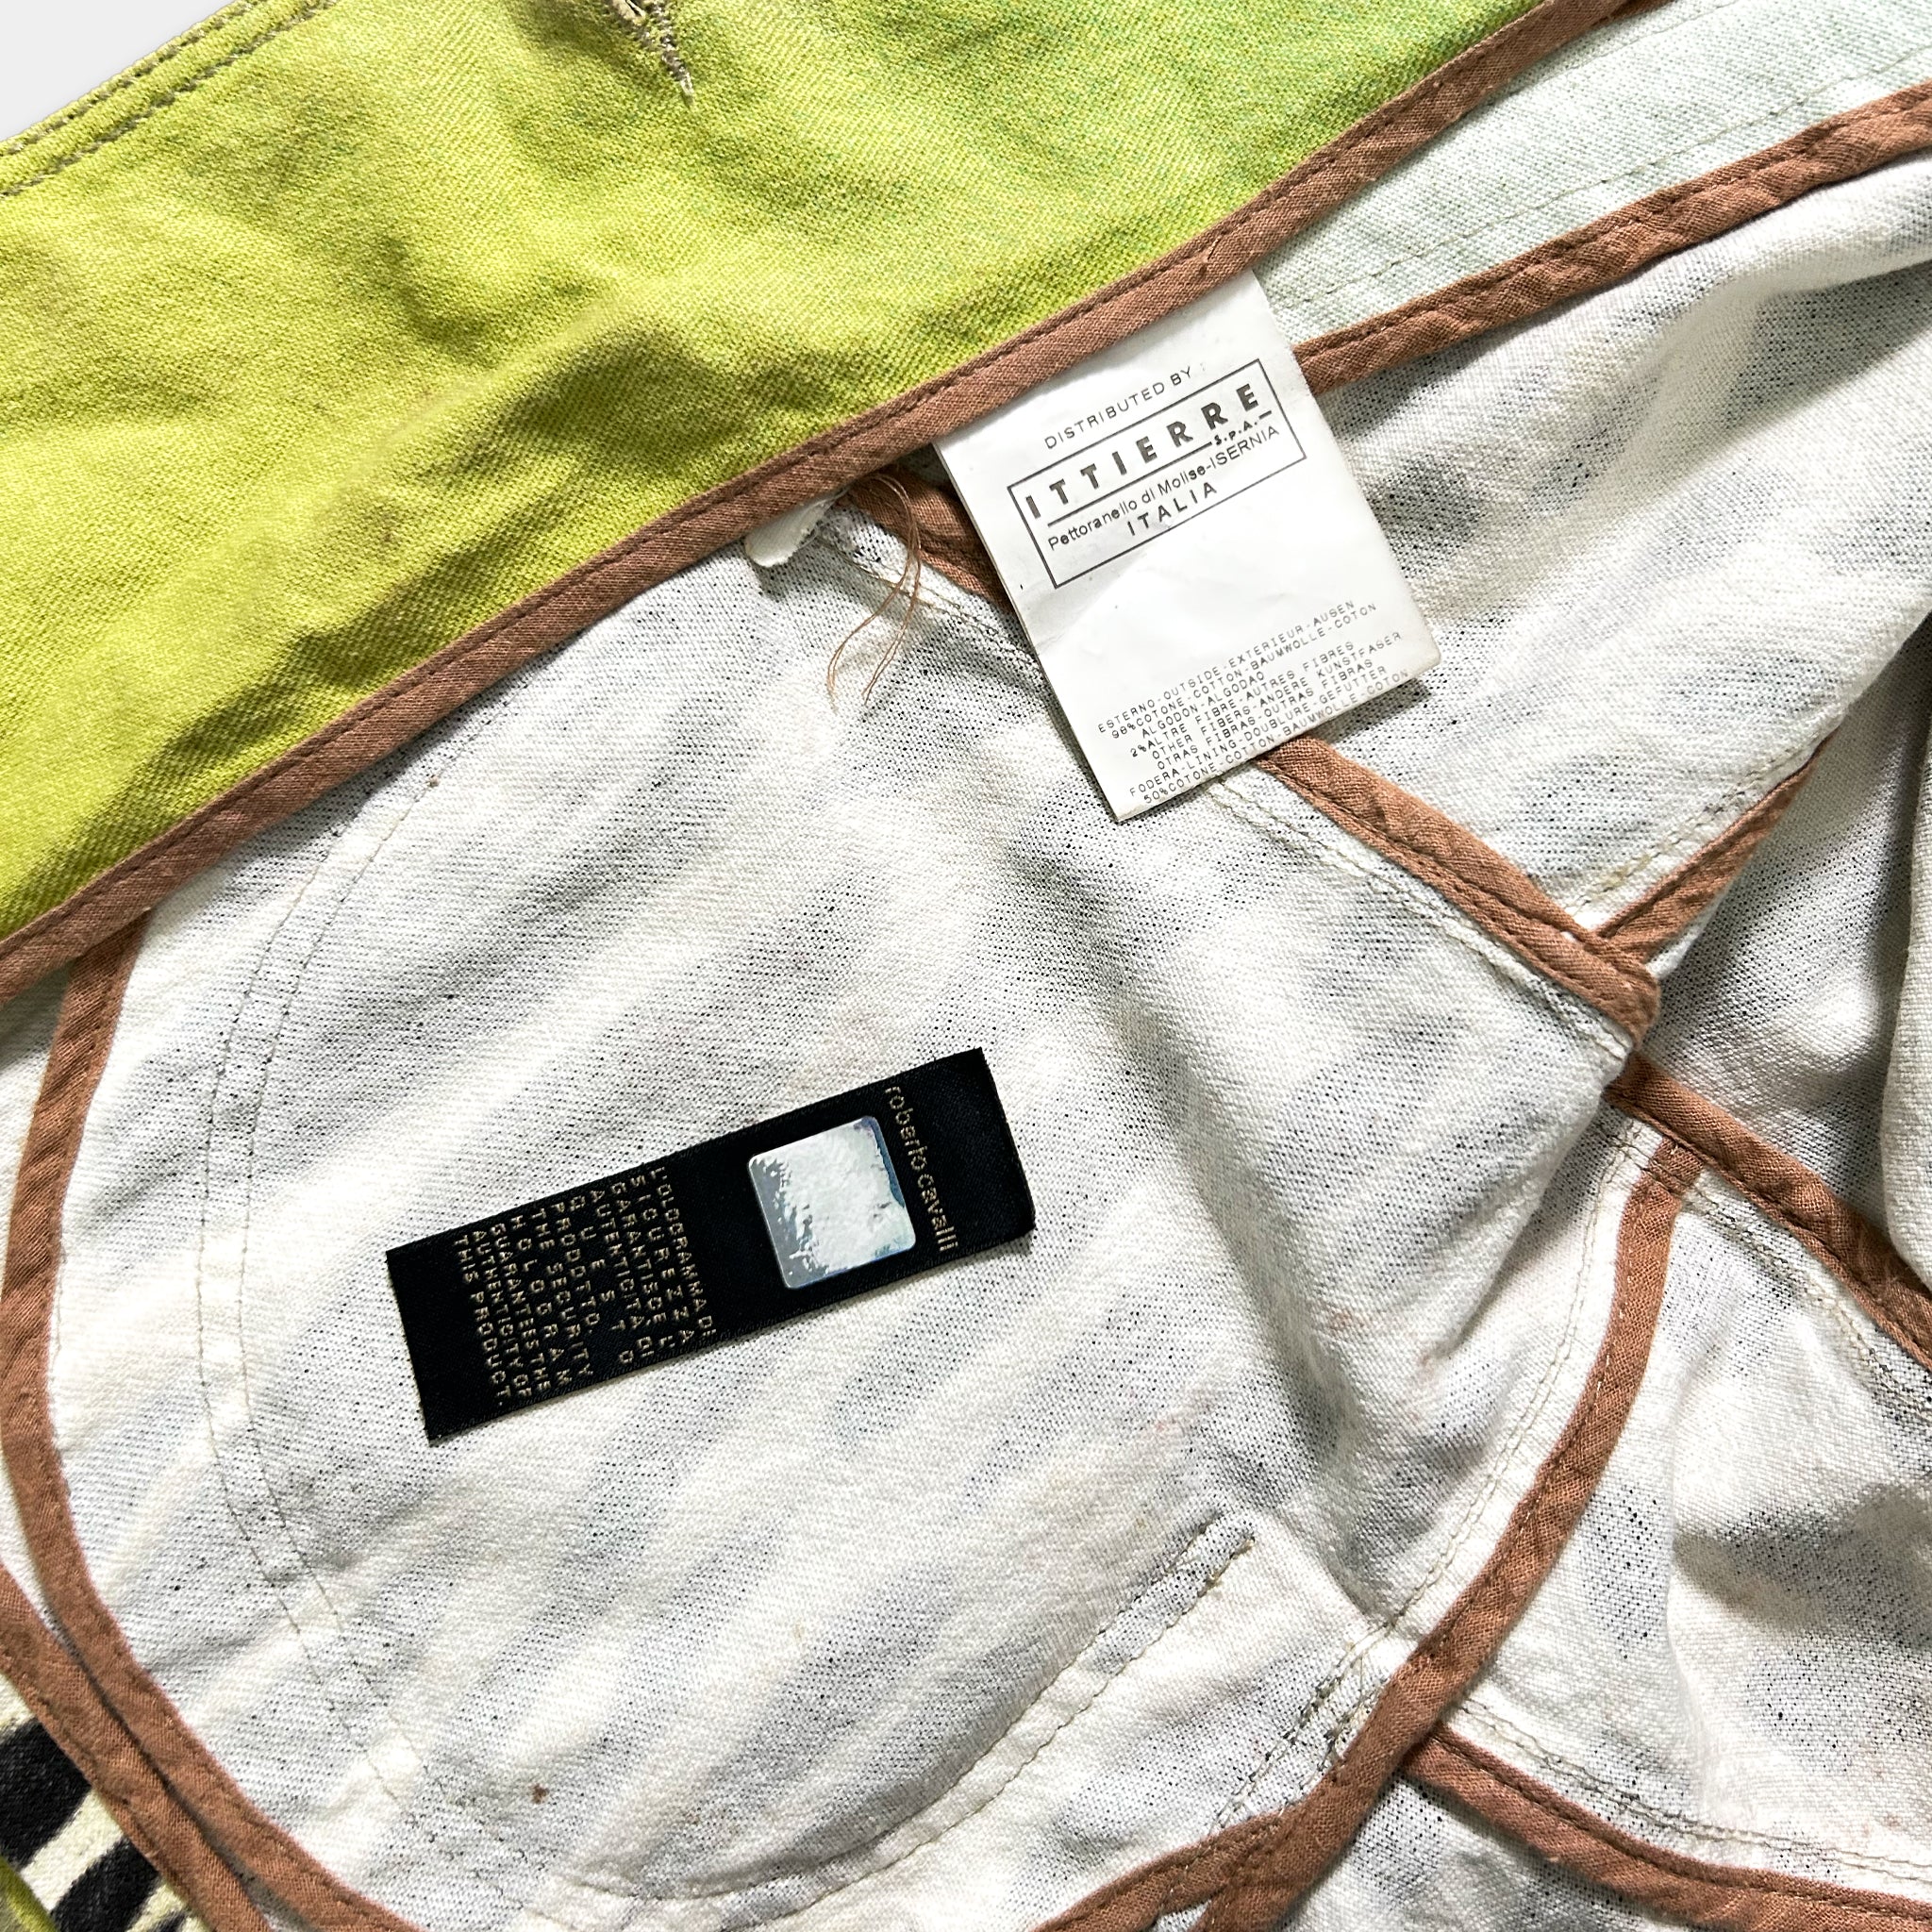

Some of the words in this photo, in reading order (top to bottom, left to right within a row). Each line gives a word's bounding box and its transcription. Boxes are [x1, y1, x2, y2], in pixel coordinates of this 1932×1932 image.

[1024, 382, 1259, 520] ITTIERRE
[1043, 381, 1165, 450] DISTRIBUTED
[1169, 365, 1191, 387] BY
[1047, 499, 1138, 552] Pettoranello
[1141, 487, 1157, 505] di
[1157, 425, 1280, 497] Molise-ISERNIA
[1125, 481, 1218, 537] ITALIA
[1152, 734, 1193, 760] OTHER
[1316, 632, 1402, 678] KUNSTFASER
[1157, 744, 1199, 771] OTRAS
[1321, 658, 1373, 690] FIBRAS
[1302, 641, 1354, 672] FIBRES
[884, 1086, 928, 1172] roberto
[917, 1173, 958, 1252] cavalli
[454, 1234, 479, 1284] THIS
[470, 1291, 511, 1407] PRODUCT.
[472, 1230, 525, 1368] AUTHENTICITY
[512, 1374, 532, 1397] OF
[490, 1223, 540, 1350] GUARANTEES
[530, 1352, 552, 1391] THE
[510, 1214, 573, 1386] HOLOGRAM
[531, 1208, 556, 1250] THE
[545, 1261, 594, 1375] SECURITY
[569, 1194, 634, 1364] QUESTO
[609, 1181, 667, 1324] GARANTISCE
[629, 1174, 695, 1344] SICUREZZA
